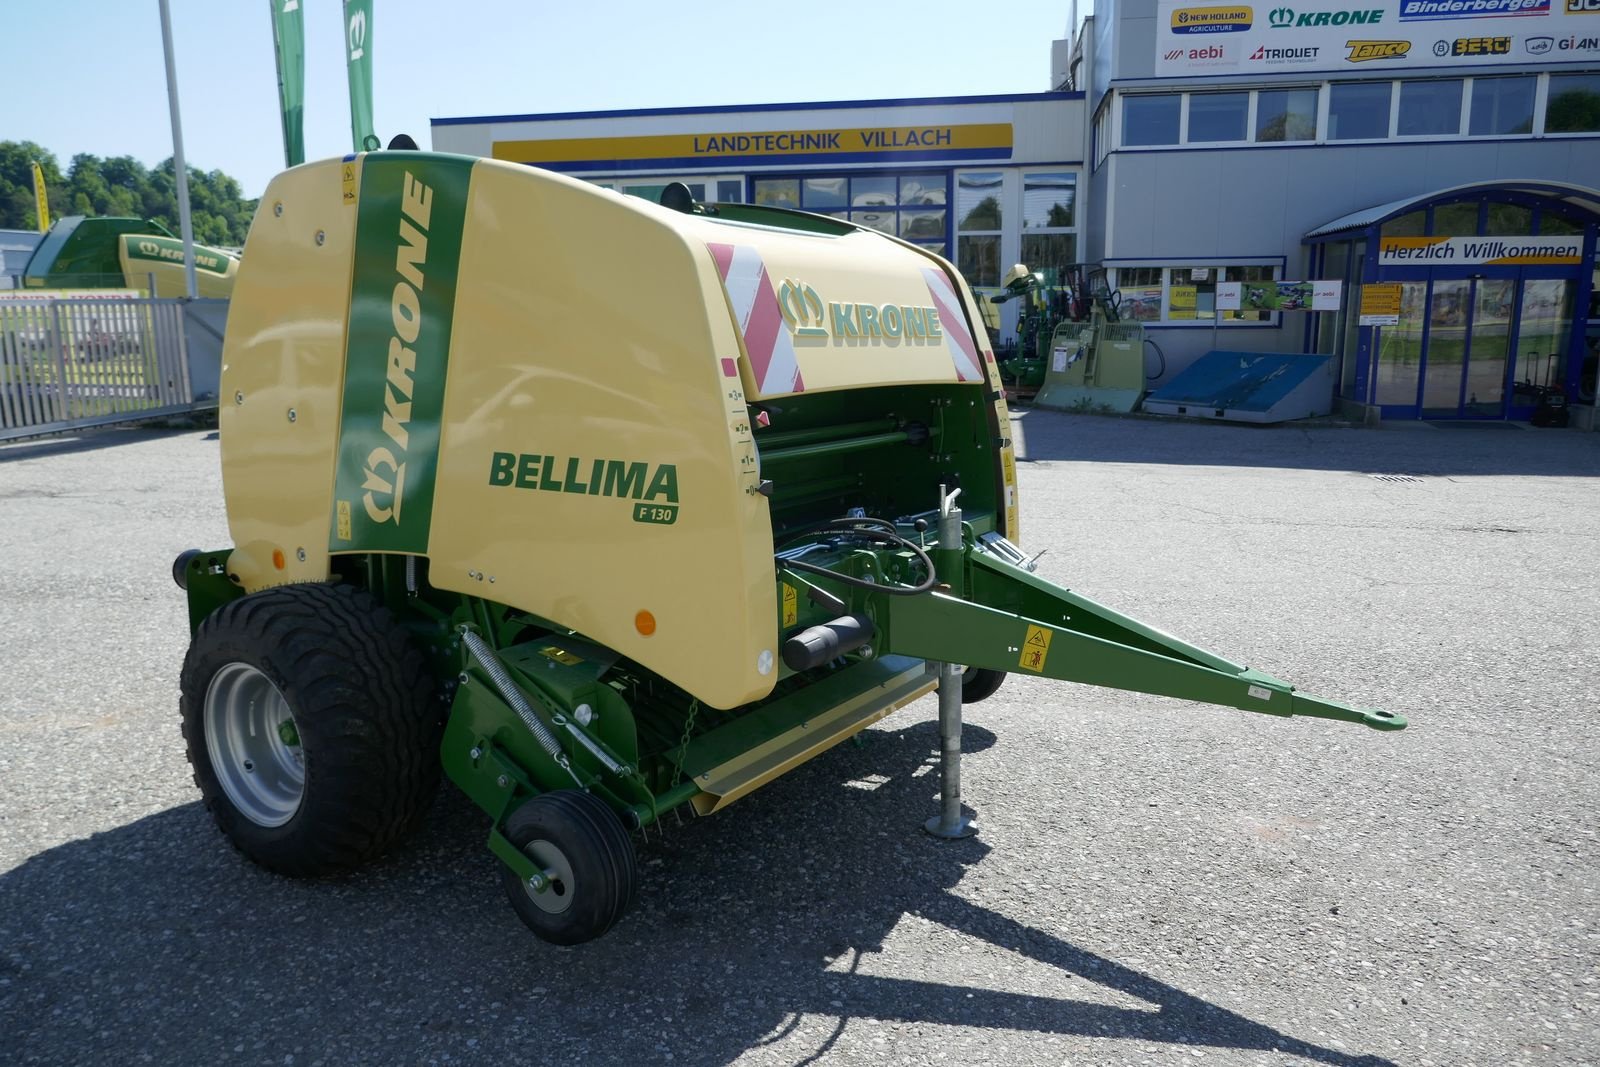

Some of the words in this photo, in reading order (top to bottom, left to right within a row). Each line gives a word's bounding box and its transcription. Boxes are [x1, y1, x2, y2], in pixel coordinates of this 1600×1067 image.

[1404, 0, 1546, 14] Binderberger
[1189, 13, 1209, 22] NEW
[1210, 12, 1246, 20] HOLLAND
[1295, 9, 1385, 27] KRONE
[1189, 25, 1233, 33] AGRICULTURE
[1188, 45, 1224, 60] aebi
[1264, 47, 1320, 60] TRIOLIET
[1345, 40, 1411, 62] Tanco
[694, 132, 841, 153] LANDTECHNIK
[860, 129, 951, 148] VILLACH
[160, 247, 218, 268] KRNE
[1384, 243, 1455, 259] Herzlich
[1463, 242, 1577, 259] Willkommen
[381, 170, 434, 452] KRONE
[828, 300, 943, 338] KRONE
[488, 451, 680, 504] BELLIMA
[639, 507, 648, 519] F
[650, 508, 672, 521] 130
